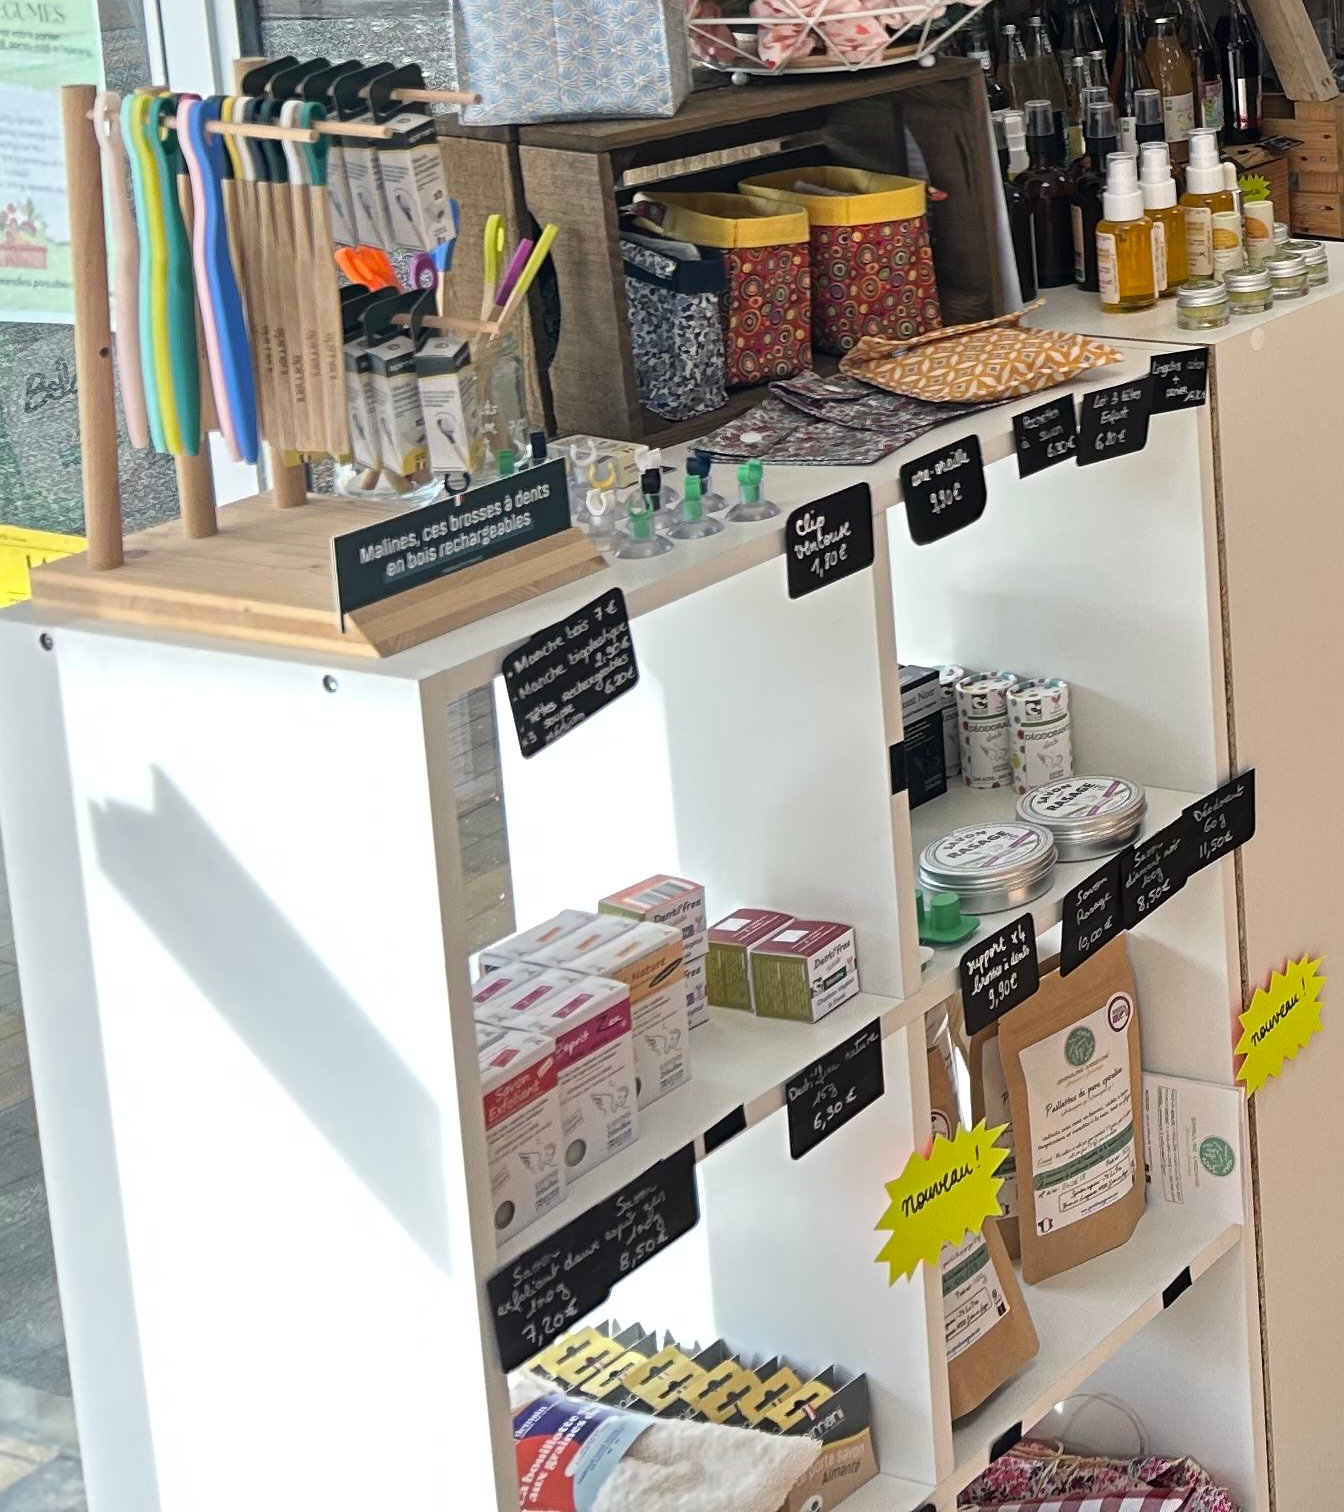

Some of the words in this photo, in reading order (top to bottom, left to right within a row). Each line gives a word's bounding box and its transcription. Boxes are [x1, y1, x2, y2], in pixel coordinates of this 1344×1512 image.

[385, 556, 406, 578] en
[405, 544, 438, 570] bois
[437, 510, 533, 559] rechargeables
[421, 519, 449, 543] ces
[448, 498, 504, 533] brosses
[503, 494, 514, 512] à
[513, 482, 551, 509] dents
